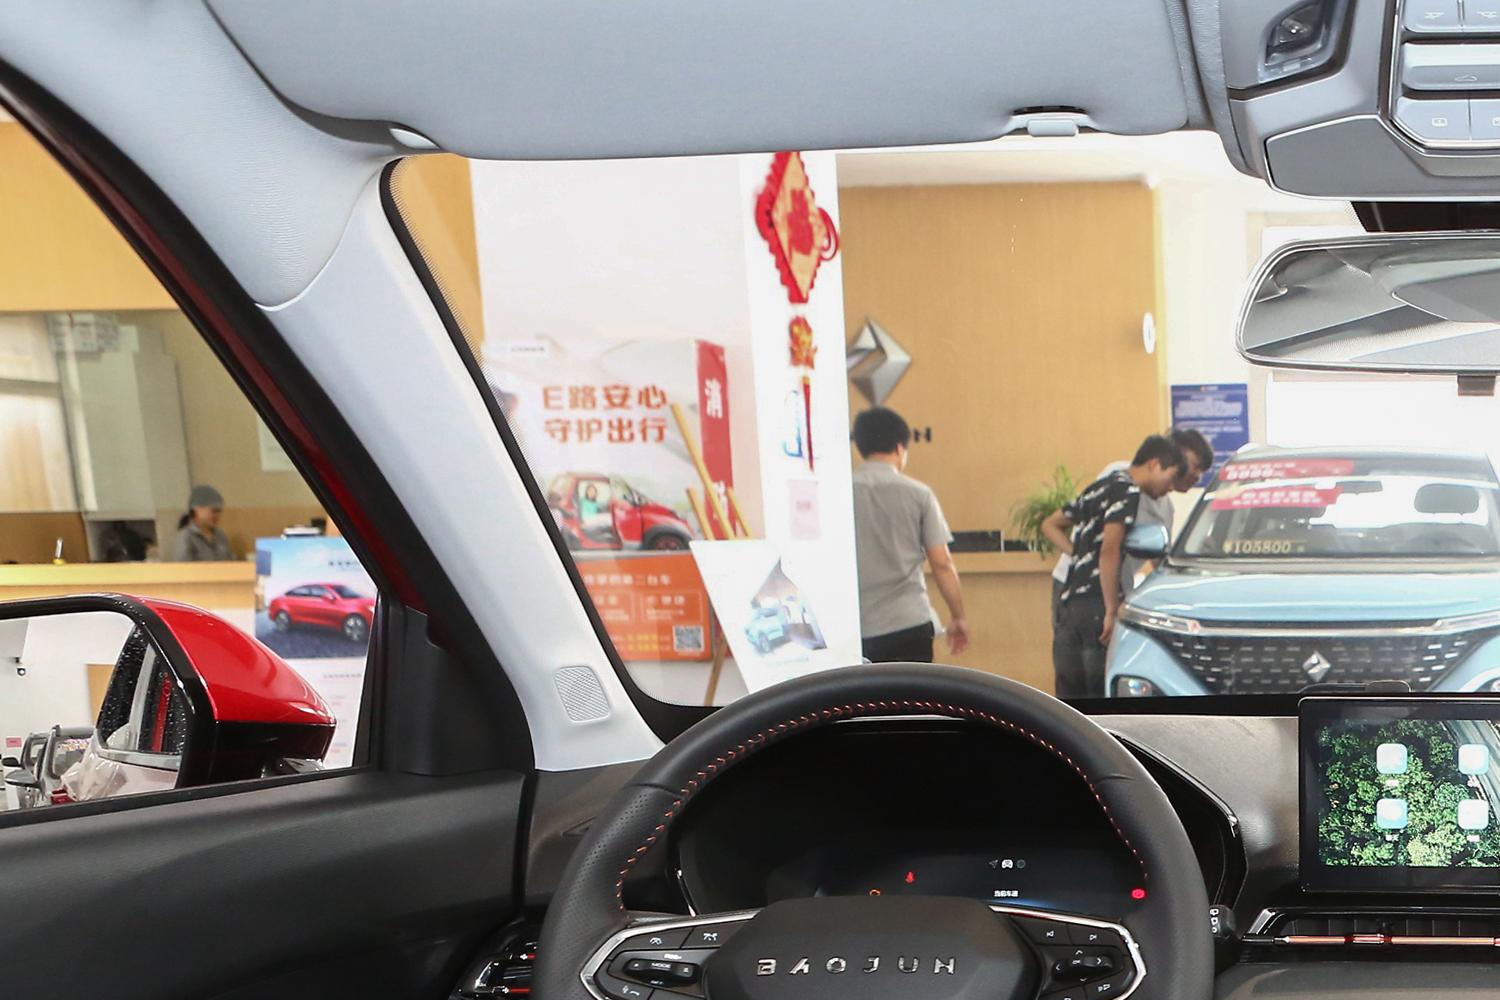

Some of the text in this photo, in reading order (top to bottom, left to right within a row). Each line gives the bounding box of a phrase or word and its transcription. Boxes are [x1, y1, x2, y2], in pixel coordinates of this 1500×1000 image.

[542, 384, 668, 411] E路安心
[543, 416, 668, 443] 守护出行
[756, 956, 956, 976] BAOJUN
